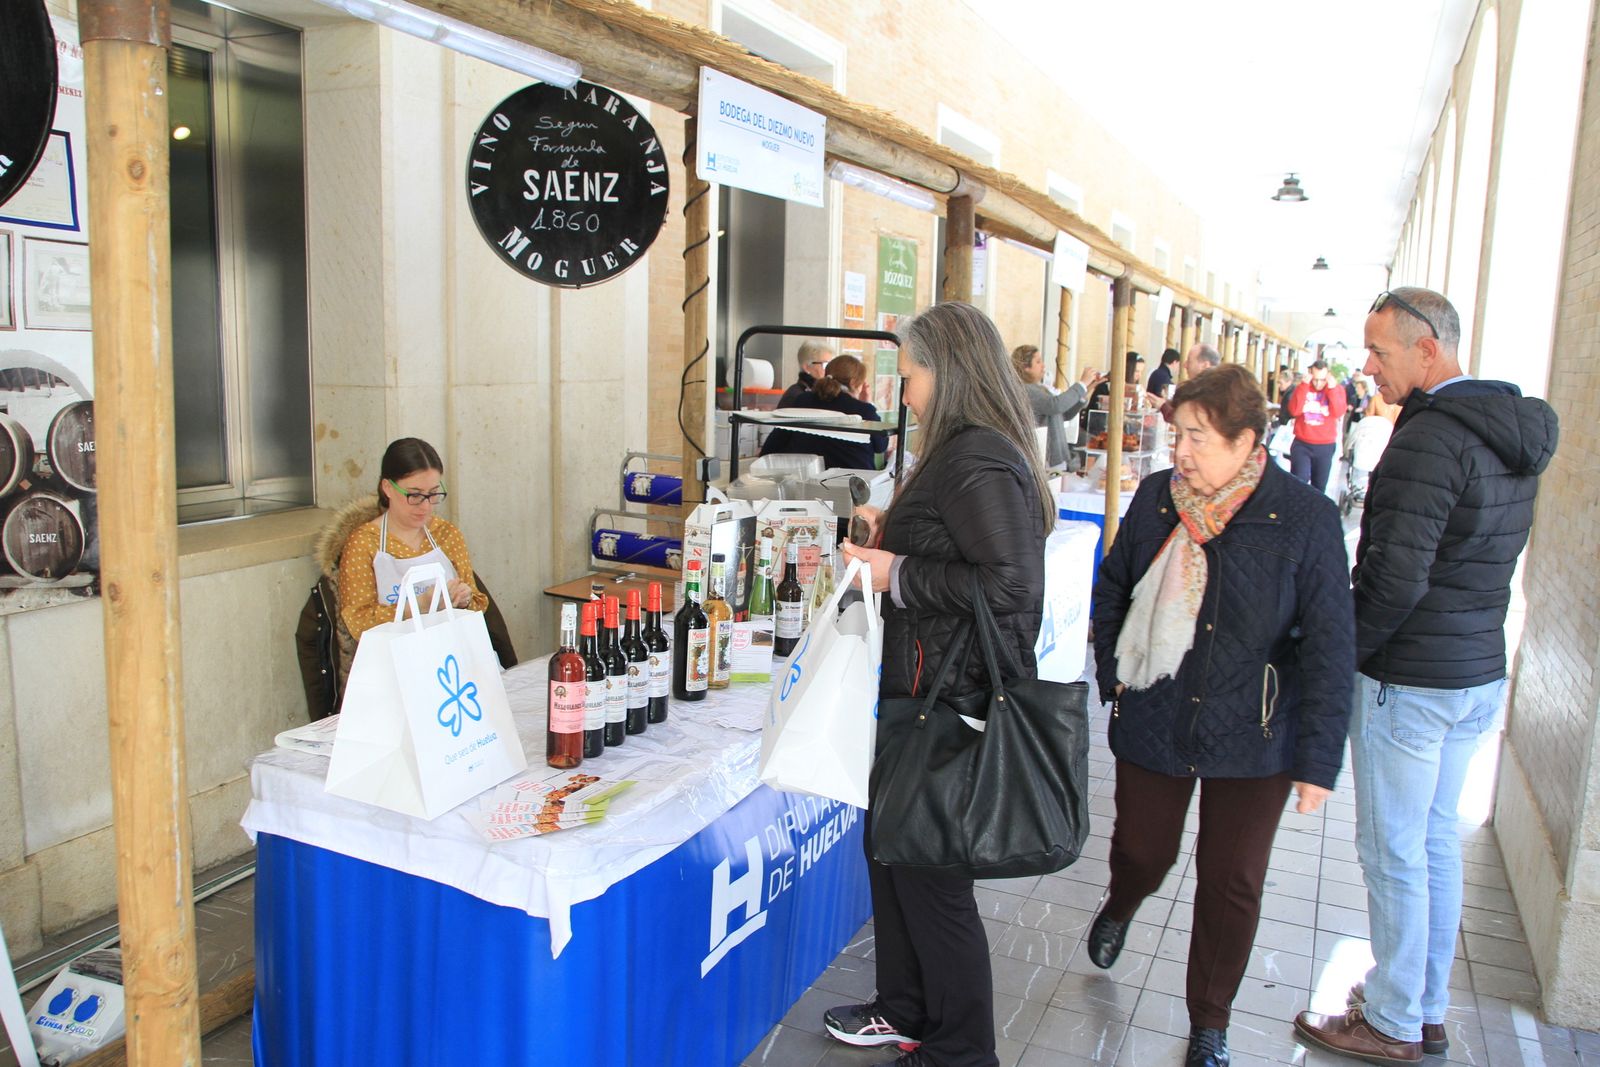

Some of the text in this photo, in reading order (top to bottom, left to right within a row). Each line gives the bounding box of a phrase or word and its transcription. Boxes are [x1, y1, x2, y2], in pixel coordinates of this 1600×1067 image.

[719, 100, 815, 147] BODEGA DEL DIEZMO NUEVO
[470, 85, 668, 197] VINO NARANJA
[761, 139, 780, 153] MOGUER
[560, 154, 580, 169] de
[522, 169, 620, 203] SAENZ
[497, 225, 640, 279] MOGUER
[77, 441, 96, 453] SAE
[29, 532, 57, 544] SAENZ
[444, 753, 458, 766] Que
[476, 732, 498, 748] Huelva
[765, 796, 840, 861] DIPUTA
[768, 805, 858, 904] DE HUELVA
